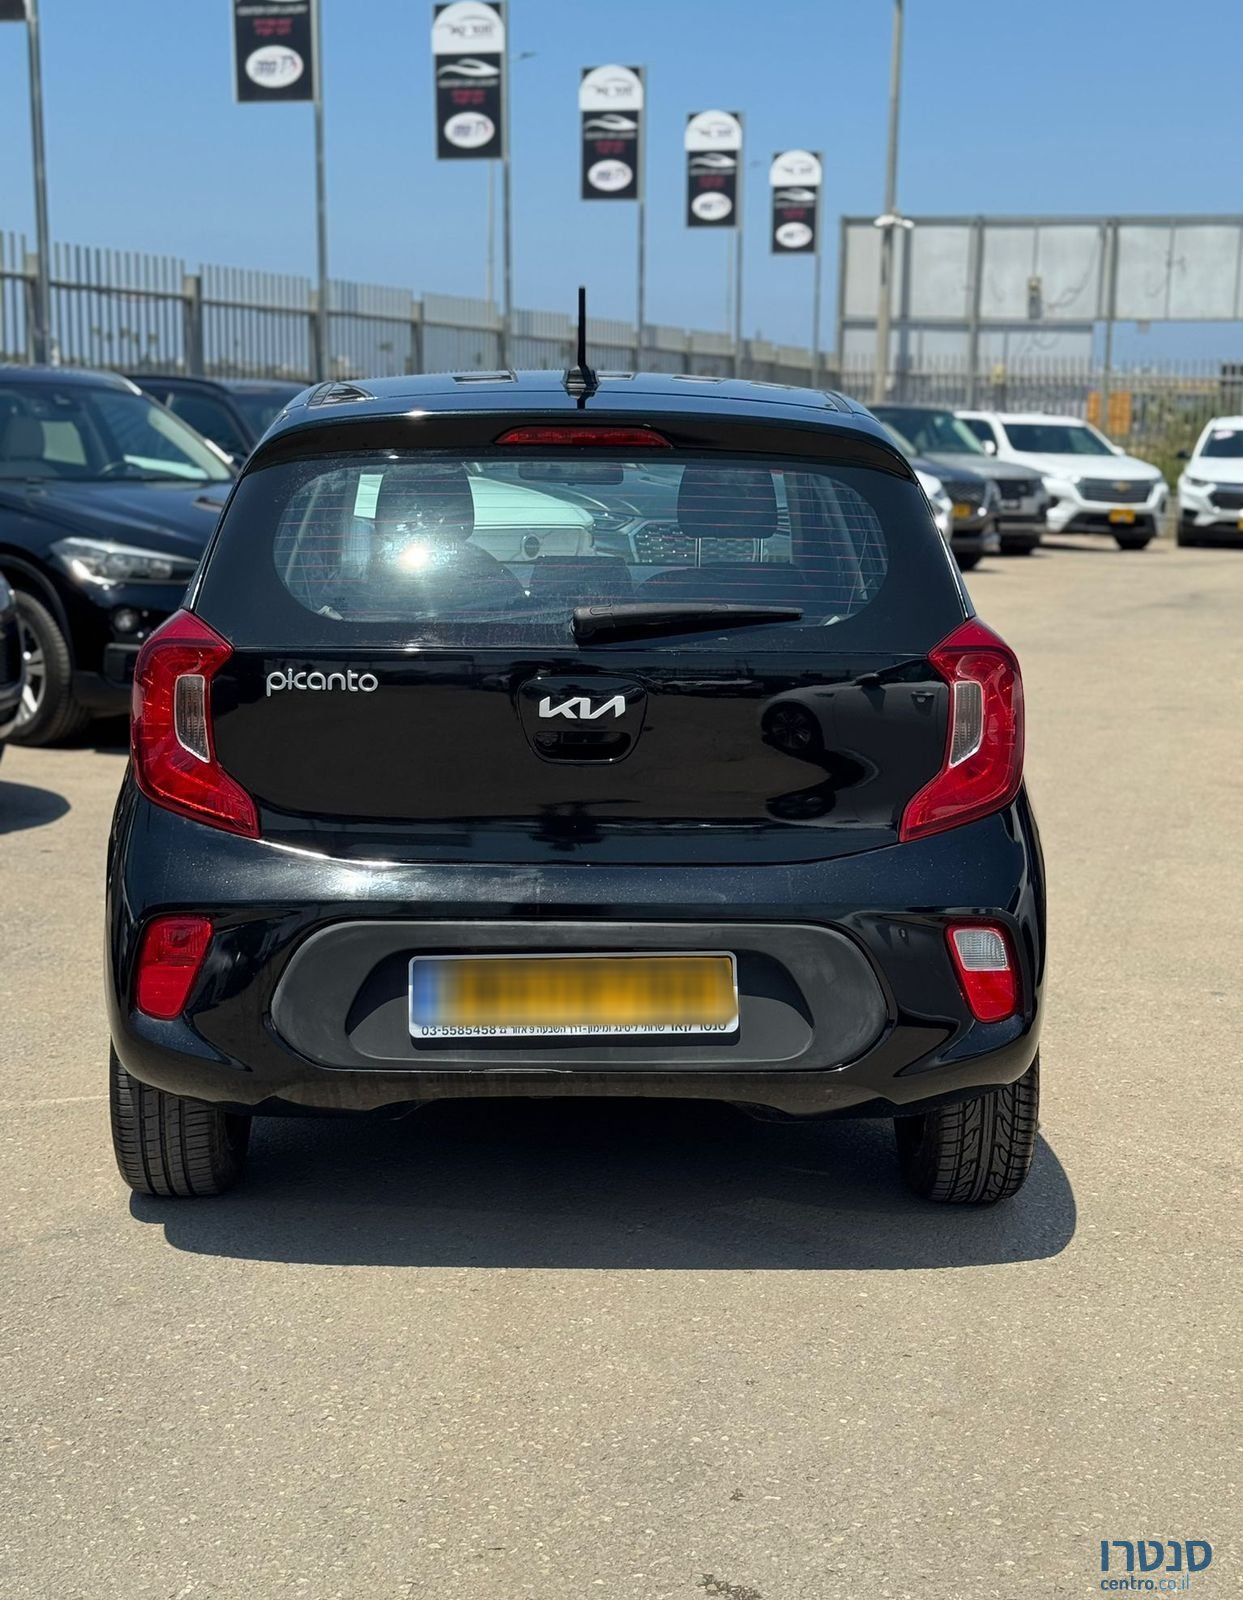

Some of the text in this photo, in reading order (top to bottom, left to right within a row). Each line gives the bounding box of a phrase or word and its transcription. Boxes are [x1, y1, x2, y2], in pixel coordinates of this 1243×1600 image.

[266, 668, 379, 697] picanto
[538, 695, 626, 720] KIA
[421, 1025, 497, 1037] 03-5585458
